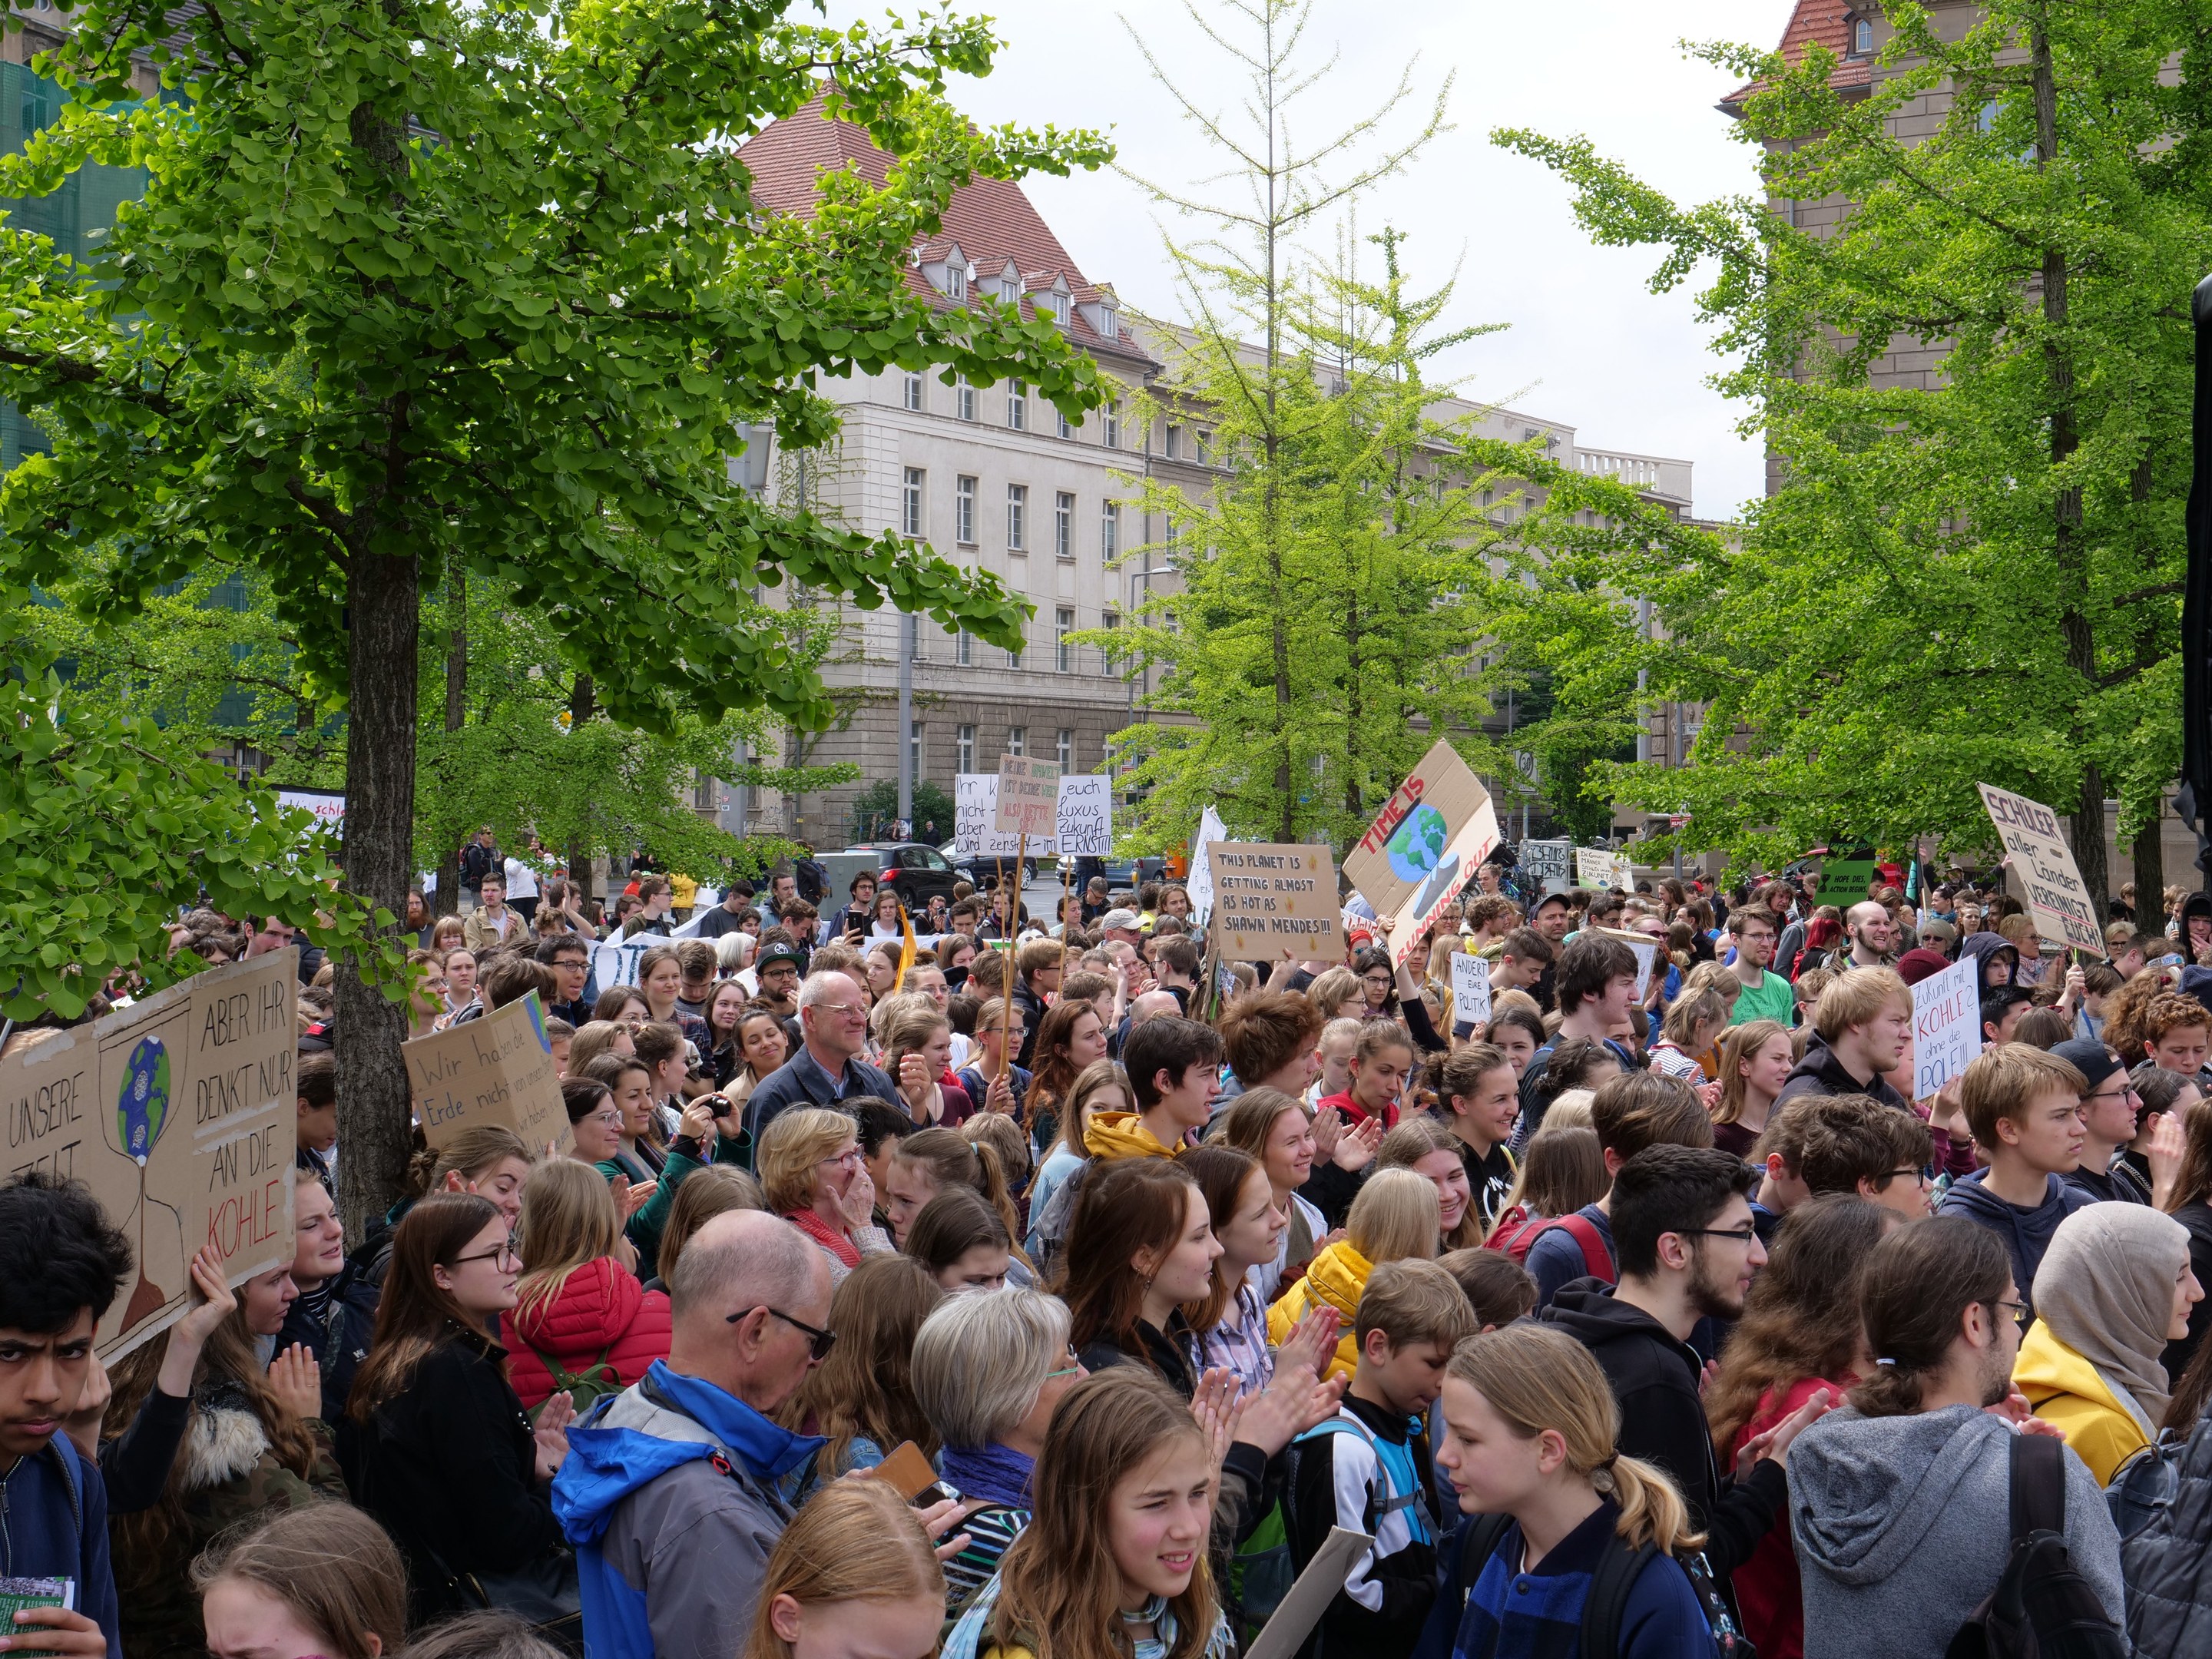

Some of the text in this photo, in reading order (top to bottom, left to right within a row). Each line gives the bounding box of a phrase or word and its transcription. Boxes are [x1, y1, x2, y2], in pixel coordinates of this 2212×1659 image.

[1004, 759, 1027, 776] DEINE
[1522, 757, 1532, 771] 30
[956, 775, 978, 796] Ihr
[1066, 779, 1101, 796] euch
[1004, 779, 1017, 793] IST
[1018, 780, 1040, 796] DEINE
[955, 795, 1099, 818] nicht Luxus
[1004, 803, 1049, 821] ALSO RETTE
[1360, 774, 1425, 855] TIME IS
[1985, 791, 2061, 842] SCHÜLER
[956, 816, 1104, 836] aber Zukunft
[1043, 839, 1057, 853] im
[1061, 834, 1111, 855] ERNST!!!
[2006, 831, 2039, 859] aller
[1218, 853, 1301, 869] THIS PLANET IS
[1220, 876, 1269, 891] GETTING
[1274, 878, 1315, 892] ALMOST
[1582, 870, 1609, 879] ZUKUNFT
[1852, 876, 1866, 884] DIES,
[2031, 858, 2080, 892] Länder
[1223, 894, 1277, 912] AS HOT AS
[1396, 835, 1493, 968] RUNNING OUT
[2024, 879, 2091, 922] VEREINIGT
[1224, 916, 1267, 932] SHAWN
[2061, 916, 2104, 952] EUCH!
[1455, 954, 1487, 979] ÄNDERT
[1953, 964, 1966, 987] mit
[1467, 979, 1482, 990] EURE
[200, 980, 286, 1053] ABER IHR
[416, 1050, 462, 1087] Wir
[472, 1025, 513, 1067] haben
[510, 1017, 525, 1050] die
[1925, 1029, 1961, 1060] ohne die
[197, 1049, 293, 1125] DENKT NUR
[9, 1070, 84, 1149] UNSERE
[423, 1091, 465, 1127] Erde
[475, 1077, 512, 1108] nicht
[209, 1124, 278, 1194] AN DIE
[207, 1179, 280, 1262] KOHLE
